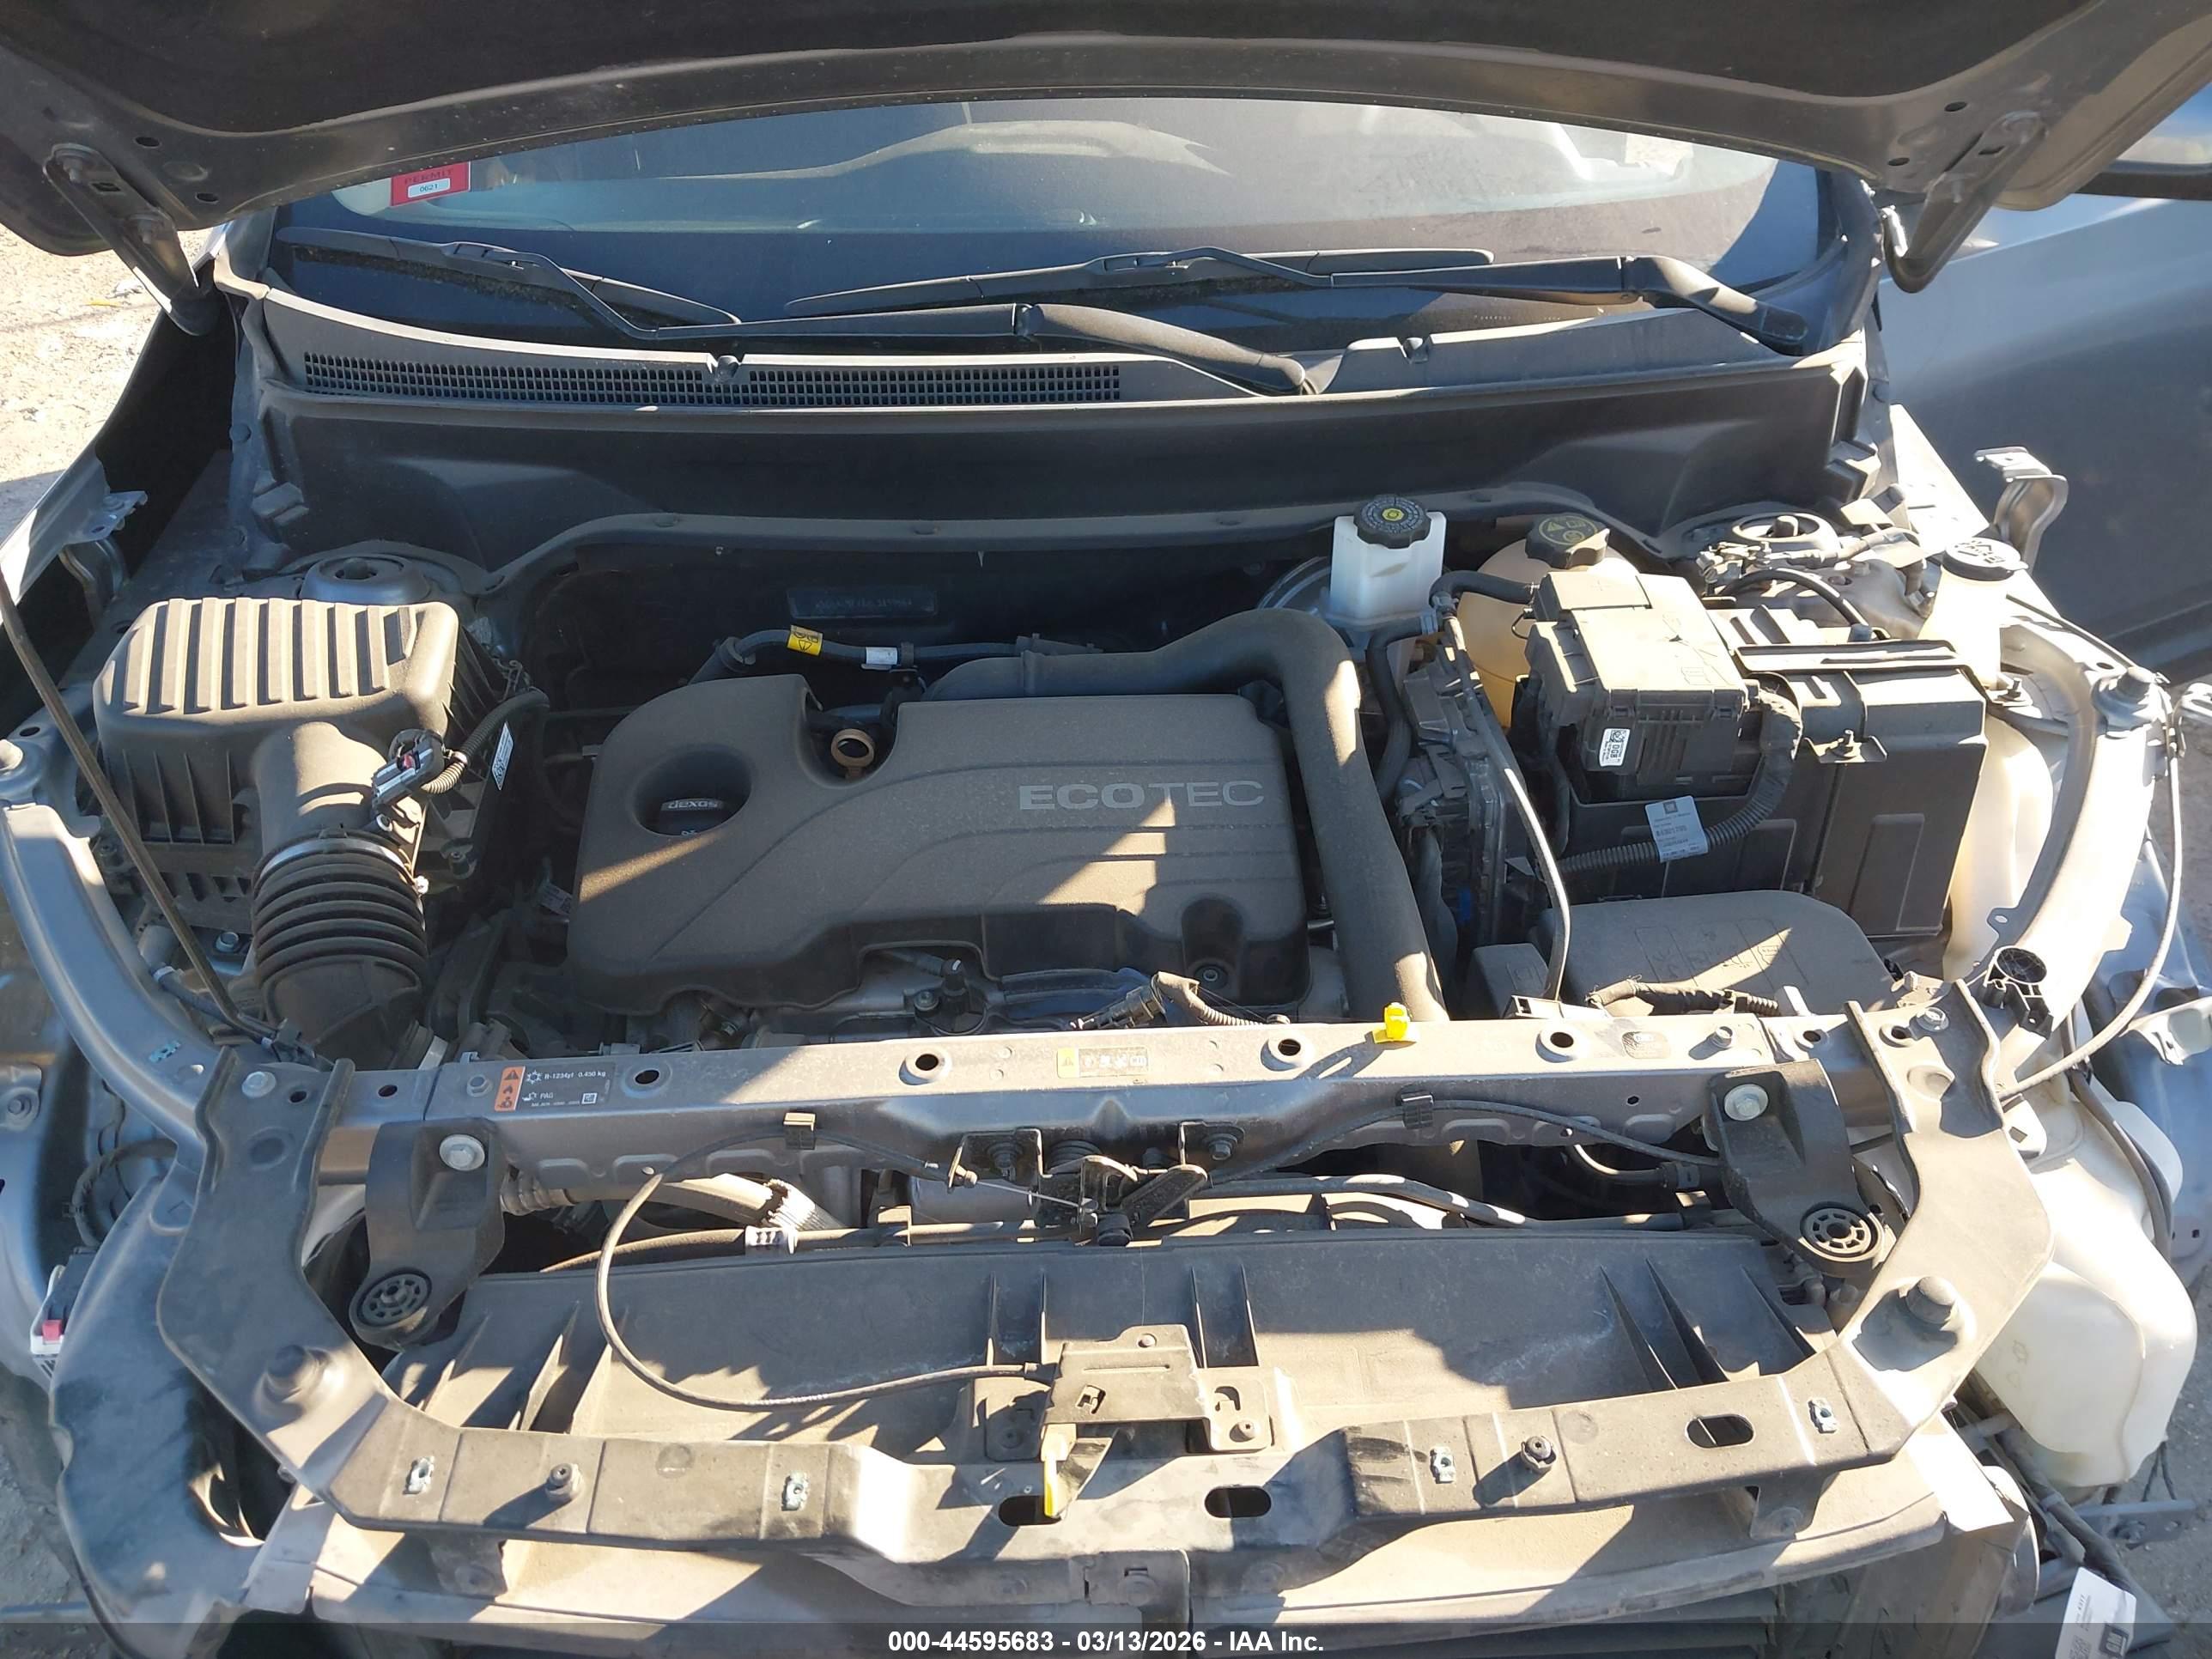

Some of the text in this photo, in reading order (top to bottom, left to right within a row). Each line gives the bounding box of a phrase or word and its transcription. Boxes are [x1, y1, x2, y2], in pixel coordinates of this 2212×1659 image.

[404, 168, 453, 185] PERMIT
[419, 183, 438, 192] 0621
[1018, 780, 1265, 810] ECOTEC
[667, 799, 718, 809] dexos
